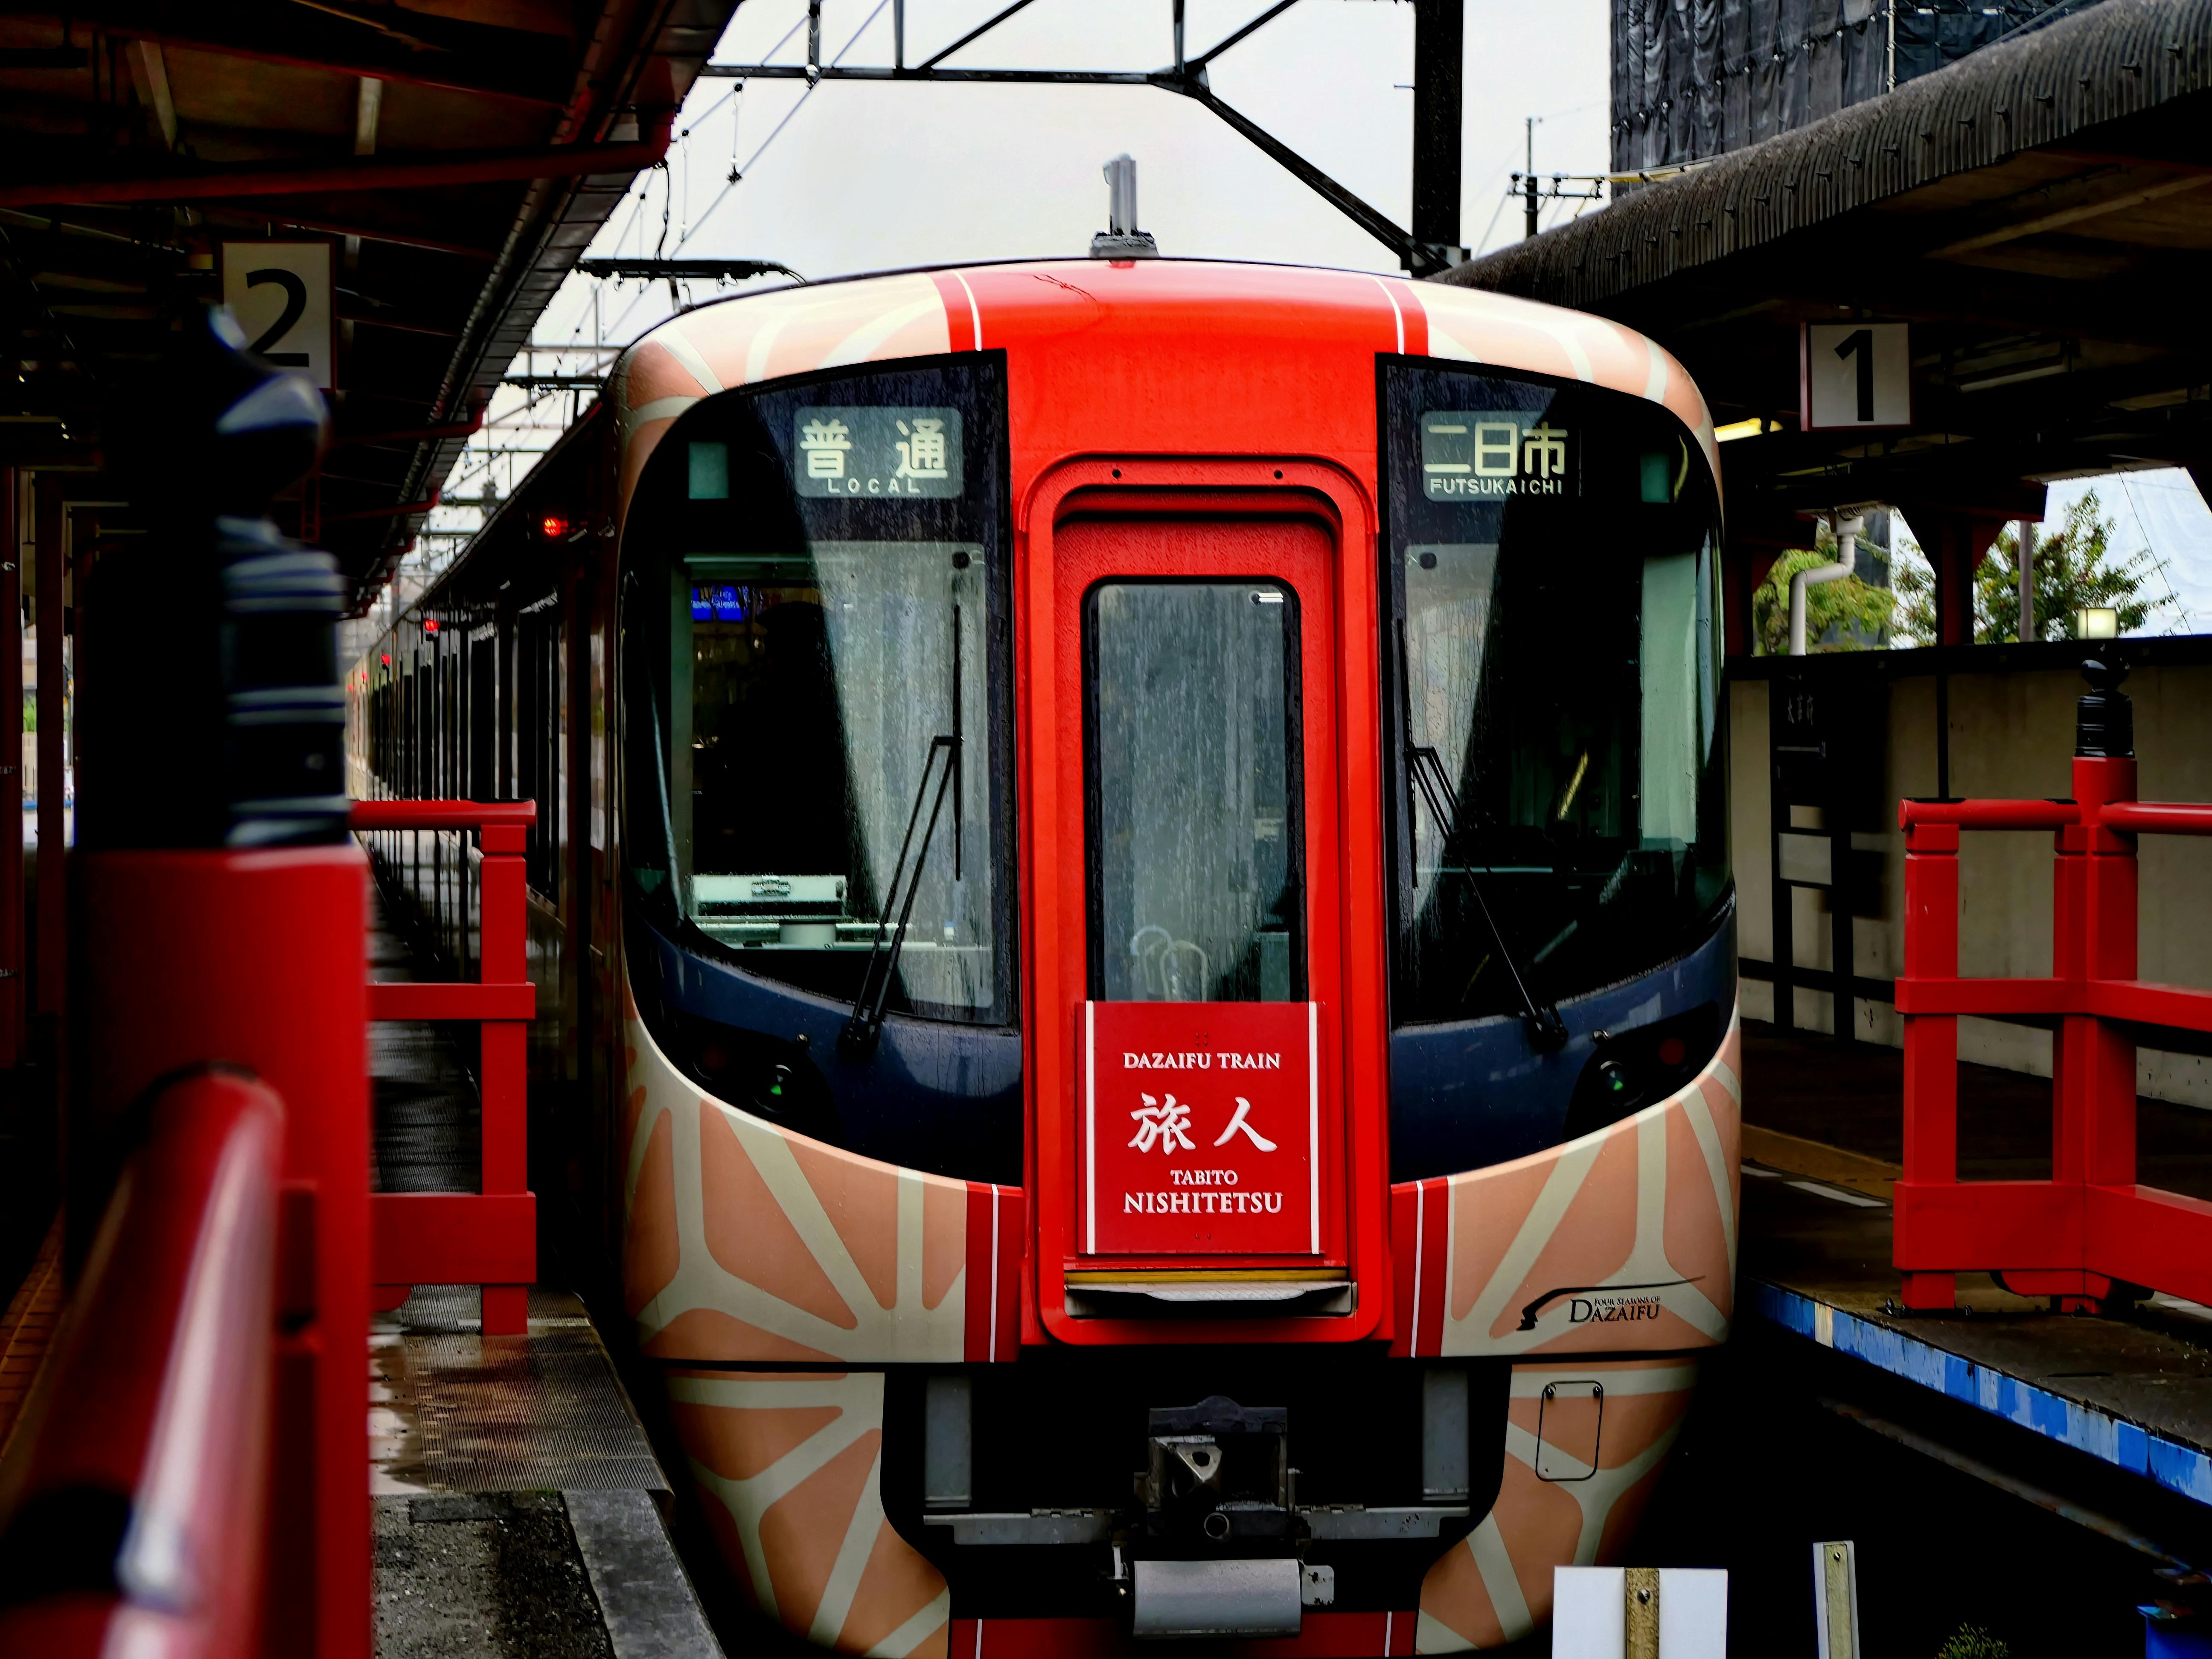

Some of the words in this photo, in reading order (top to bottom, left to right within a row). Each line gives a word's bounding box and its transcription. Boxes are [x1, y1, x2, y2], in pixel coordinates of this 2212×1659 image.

[246, 268, 309, 367] 2
[1834, 329, 1874, 422] 1
[800, 418, 948, 479] 普通
[1423, 421, 1568, 479] 二日市
[827, 477, 921, 494] LOCAL
[1430, 478, 1562, 495] FUTSUKAICHI
[1123, 1052, 1211, 1069] DAZAIFU
[1217, 1052, 1281, 1069] TRAIN
[1127, 1092, 1278, 1155] 旅人
[1170, 1170, 1238, 1185] TABITO
[1123, 1192, 1283, 1214] NISHITETSU
[1569, 1299, 1660, 1323] DAZAIFU
[1594, 1298, 1615, 1307] FOUR
[1650, 1295, 1660, 1304] OF
